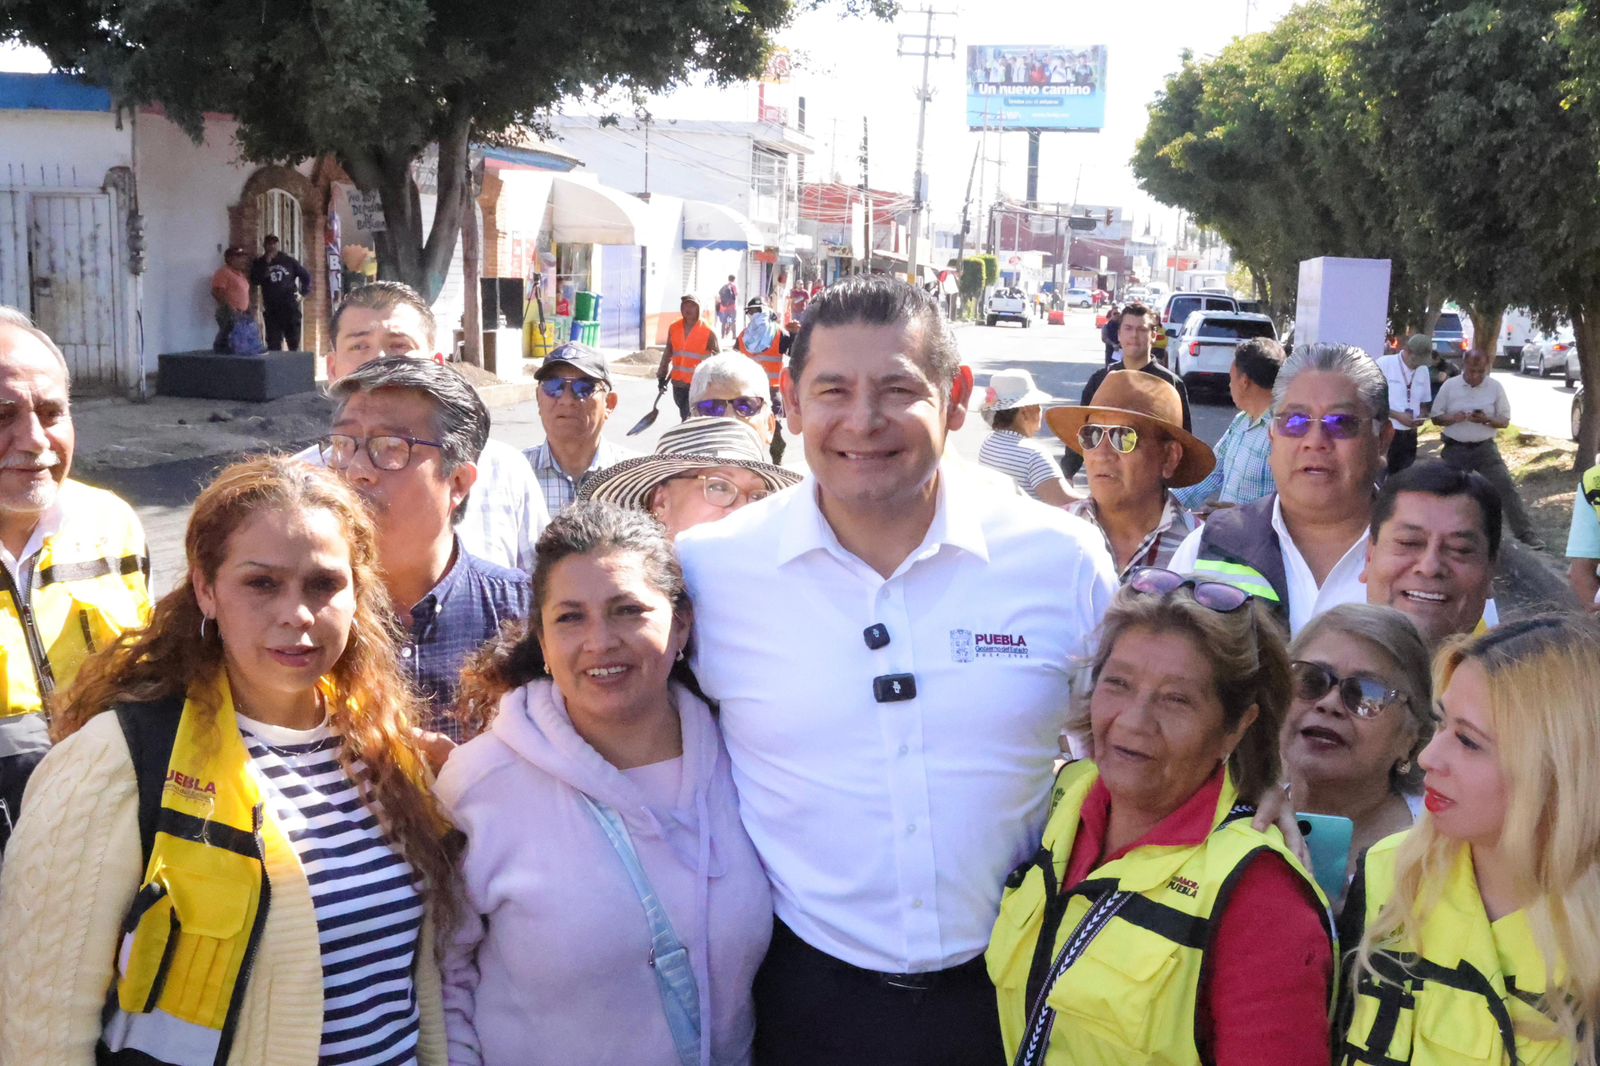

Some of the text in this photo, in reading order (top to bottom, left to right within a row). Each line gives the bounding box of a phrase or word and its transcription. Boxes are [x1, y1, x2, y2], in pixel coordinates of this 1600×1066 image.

[979, 84, 1091, 95] Un nuevo camino
[975, 634, 1027, 647] PUEBLA
[165, 769, 217, 795] UEBLA
[1166, 880, 1198, 899] PUEBLA
